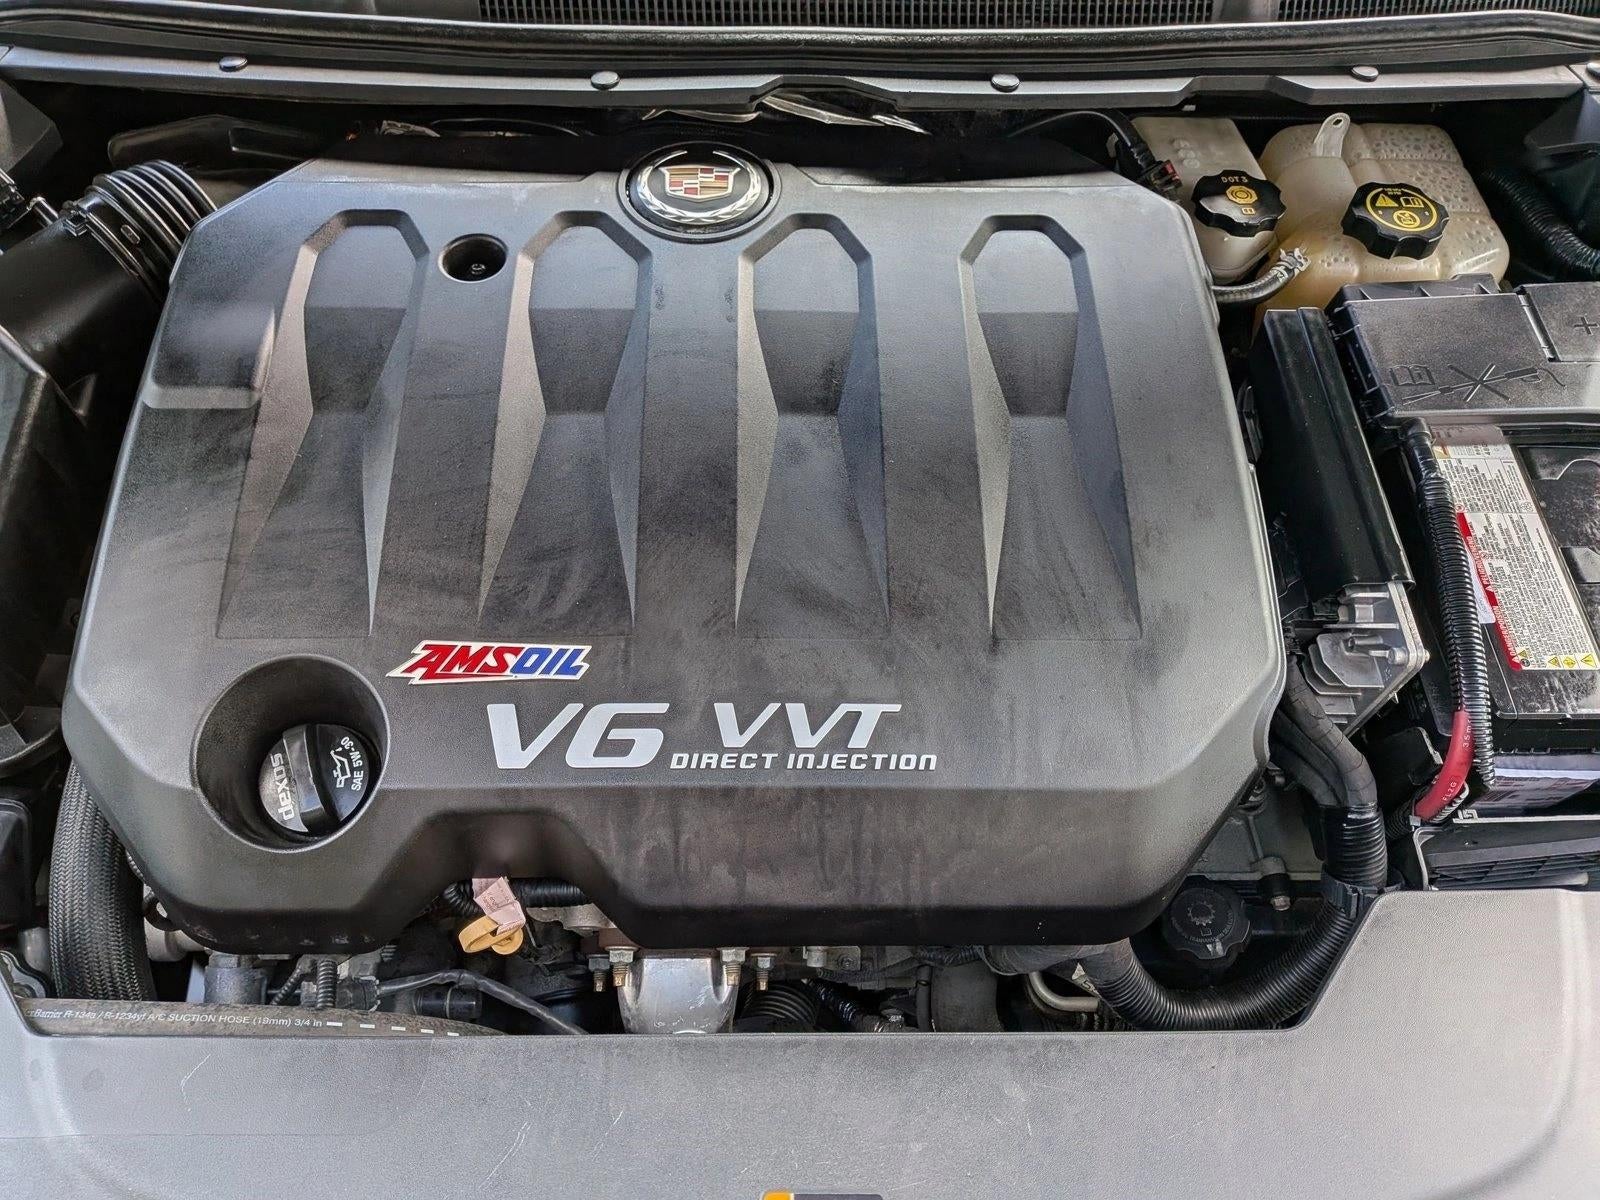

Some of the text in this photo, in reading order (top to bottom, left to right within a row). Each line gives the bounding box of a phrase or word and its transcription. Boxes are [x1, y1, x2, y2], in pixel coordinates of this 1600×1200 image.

[401, 643, 585, 681] AMSOIL
[487, 702, 902, 769] V6 VVT
[340, 736, 364, 791] SAE 5W-30
[670, 752, 778, 770] DIRECT
[168, 1013, 217, 1023] SUCTION
[218, 1014, 250, 1024] HOSE
[252, 1016, 292, 1027] (19mm)
[294, 1018, 311, 1027] 3/4
[312, 1019, 323, 1027] in
